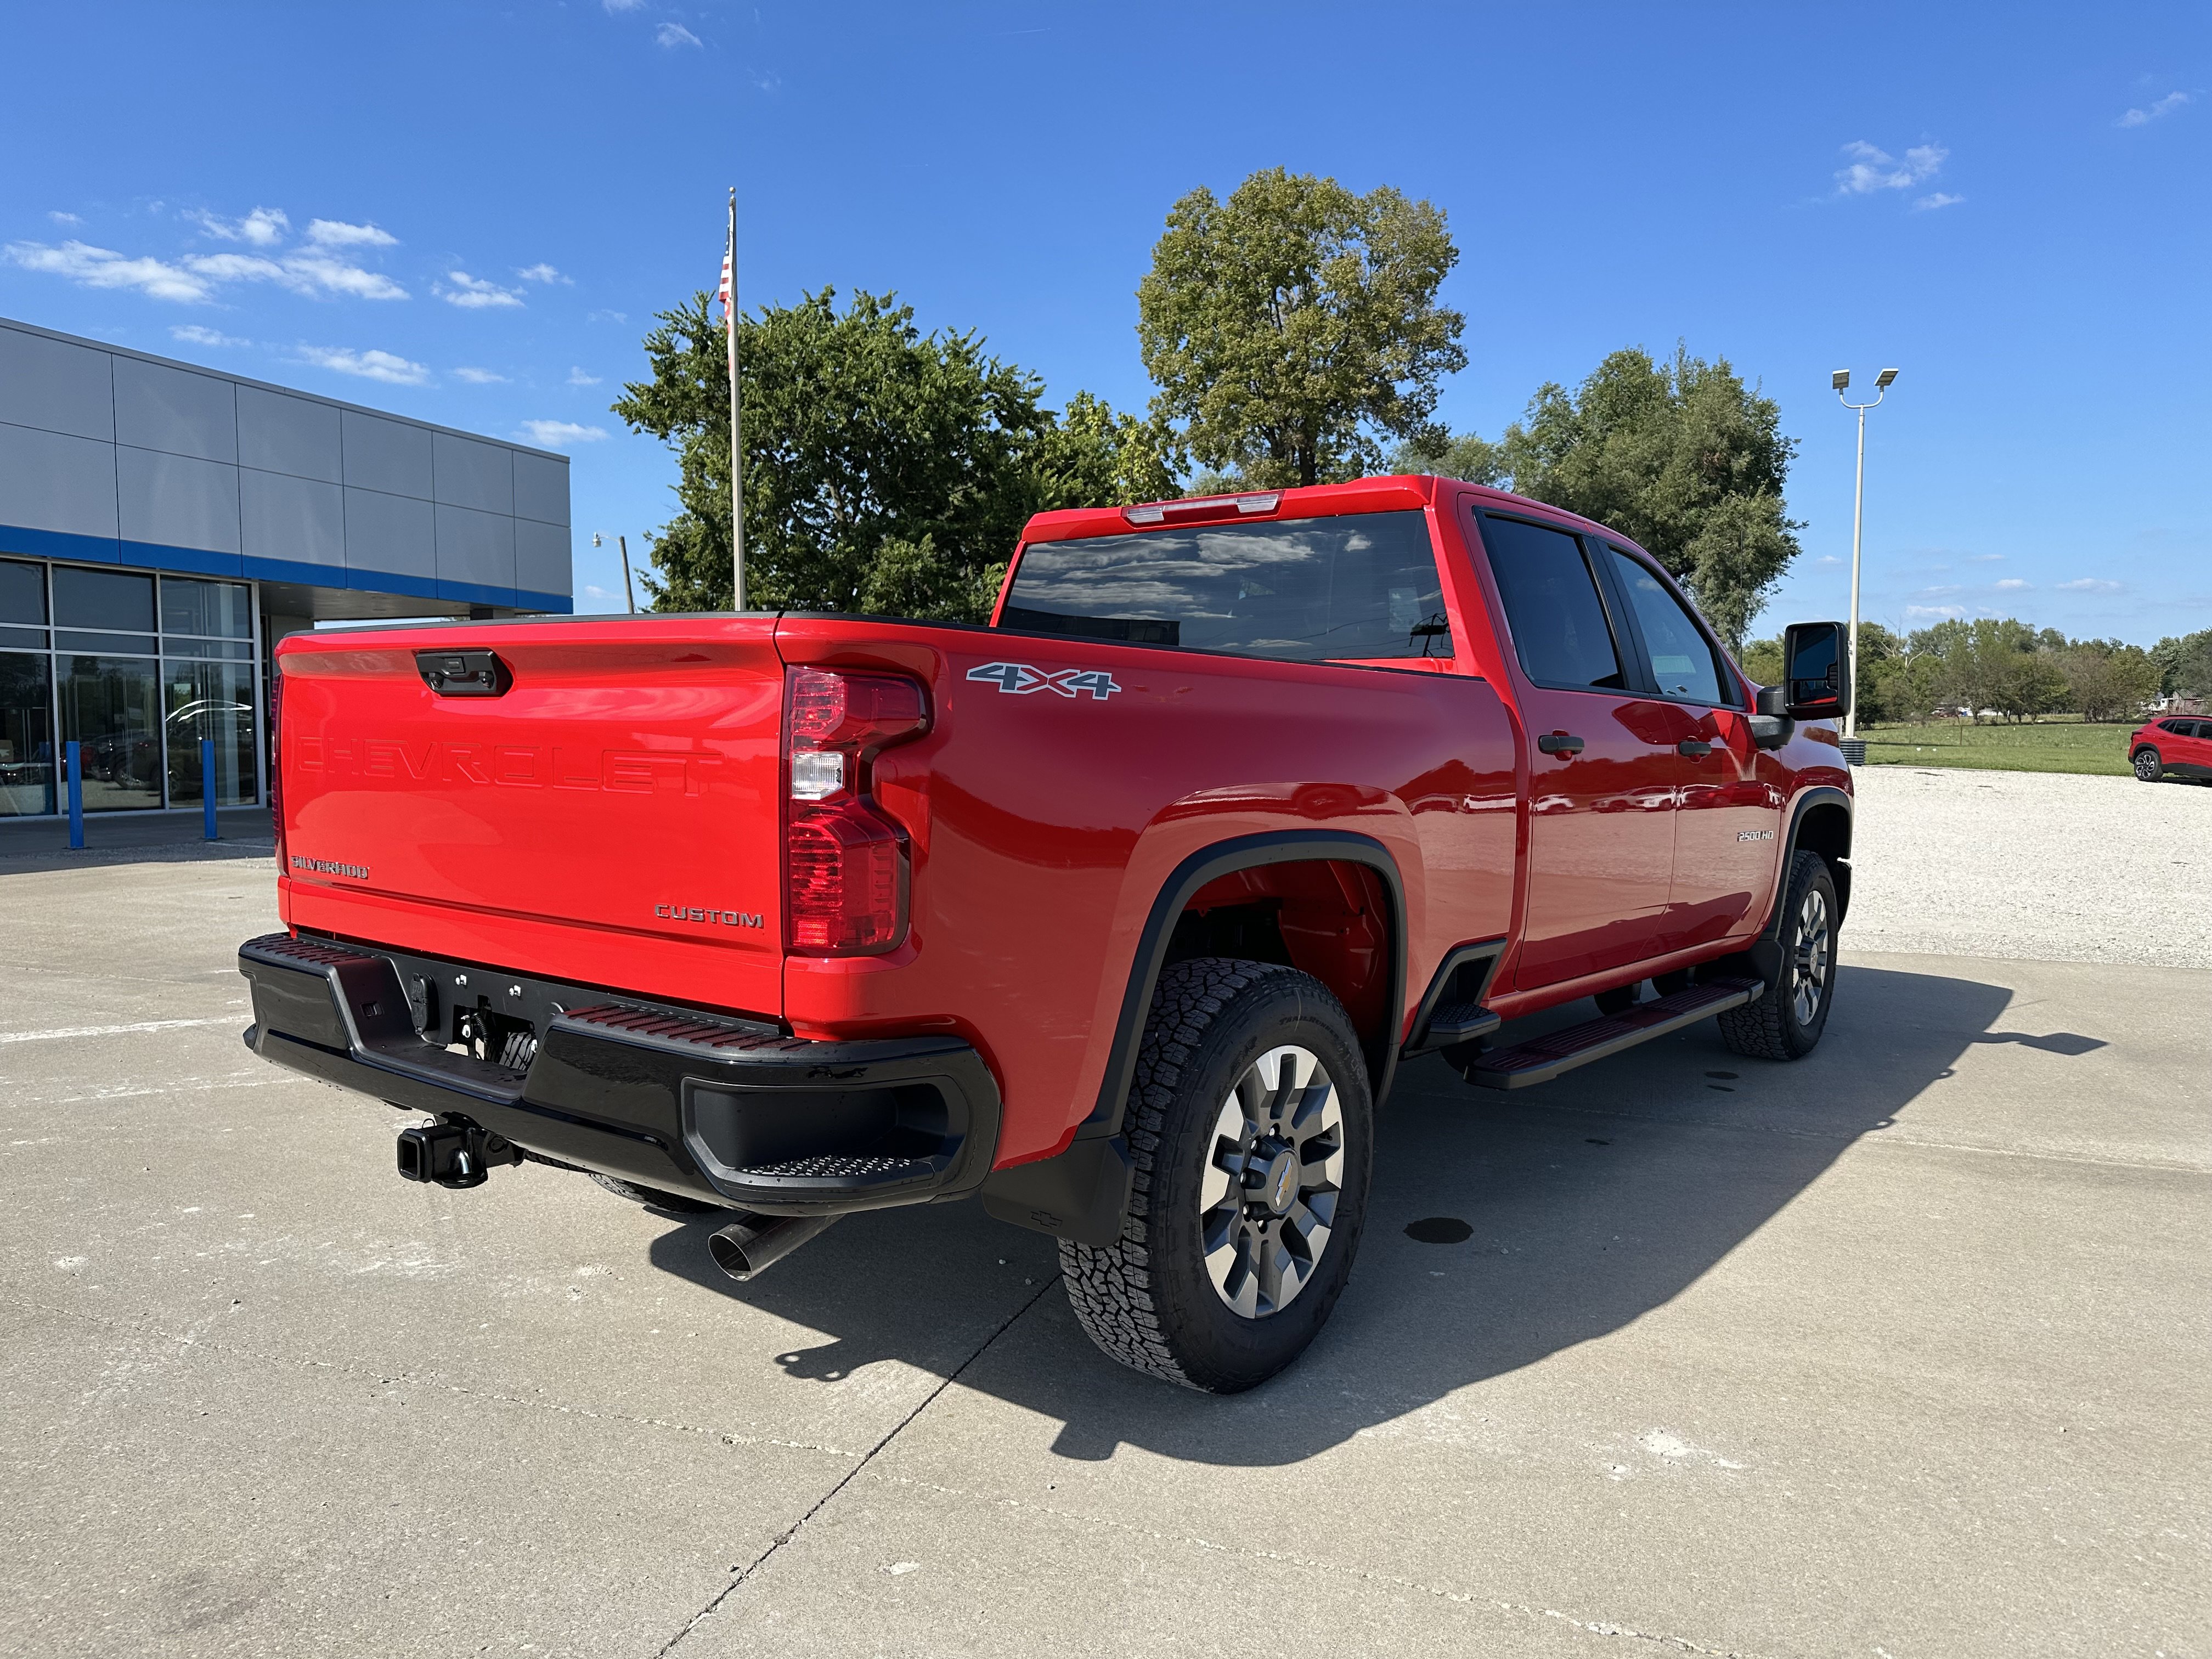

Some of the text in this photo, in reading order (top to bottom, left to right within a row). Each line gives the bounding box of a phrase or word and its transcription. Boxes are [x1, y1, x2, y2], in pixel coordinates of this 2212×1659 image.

[298, 735, 724, 797] CHEVROLET
[291, 856, 369, 880] SILVERADO
[654, 904, 764, 929] CUSTOM
